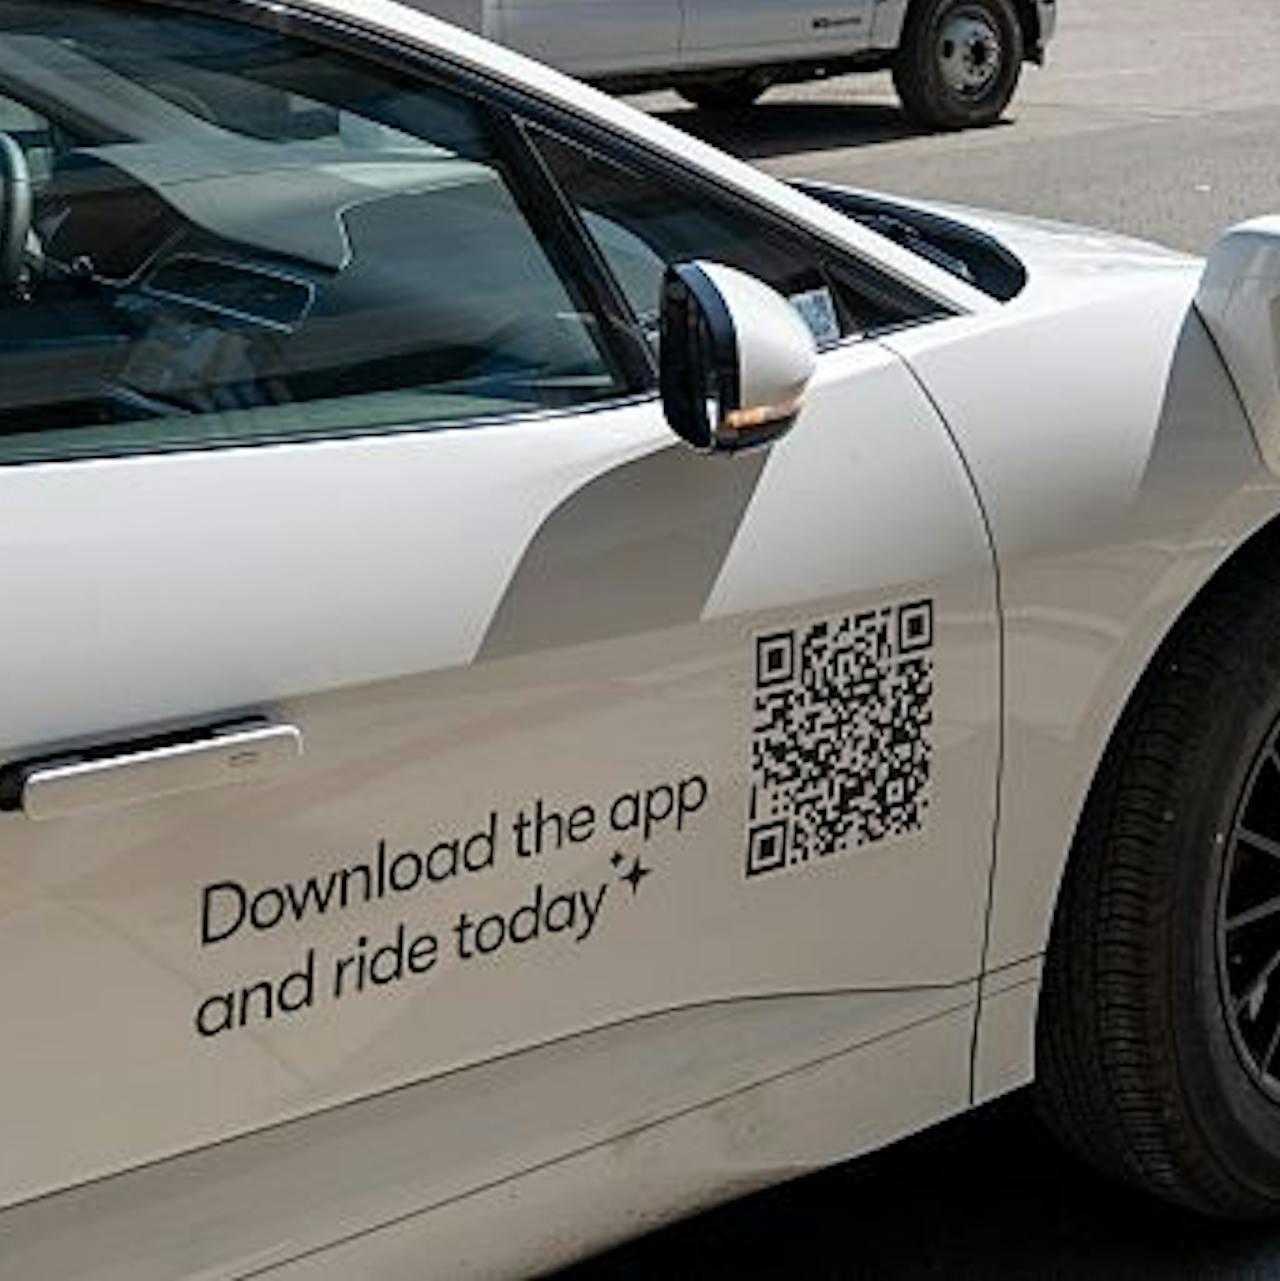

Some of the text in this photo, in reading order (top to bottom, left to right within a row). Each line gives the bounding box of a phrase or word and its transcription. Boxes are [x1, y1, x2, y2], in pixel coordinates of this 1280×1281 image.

[200, 774, 708, 948] Download the app
[194, 882, 609, 1038] and ride today
